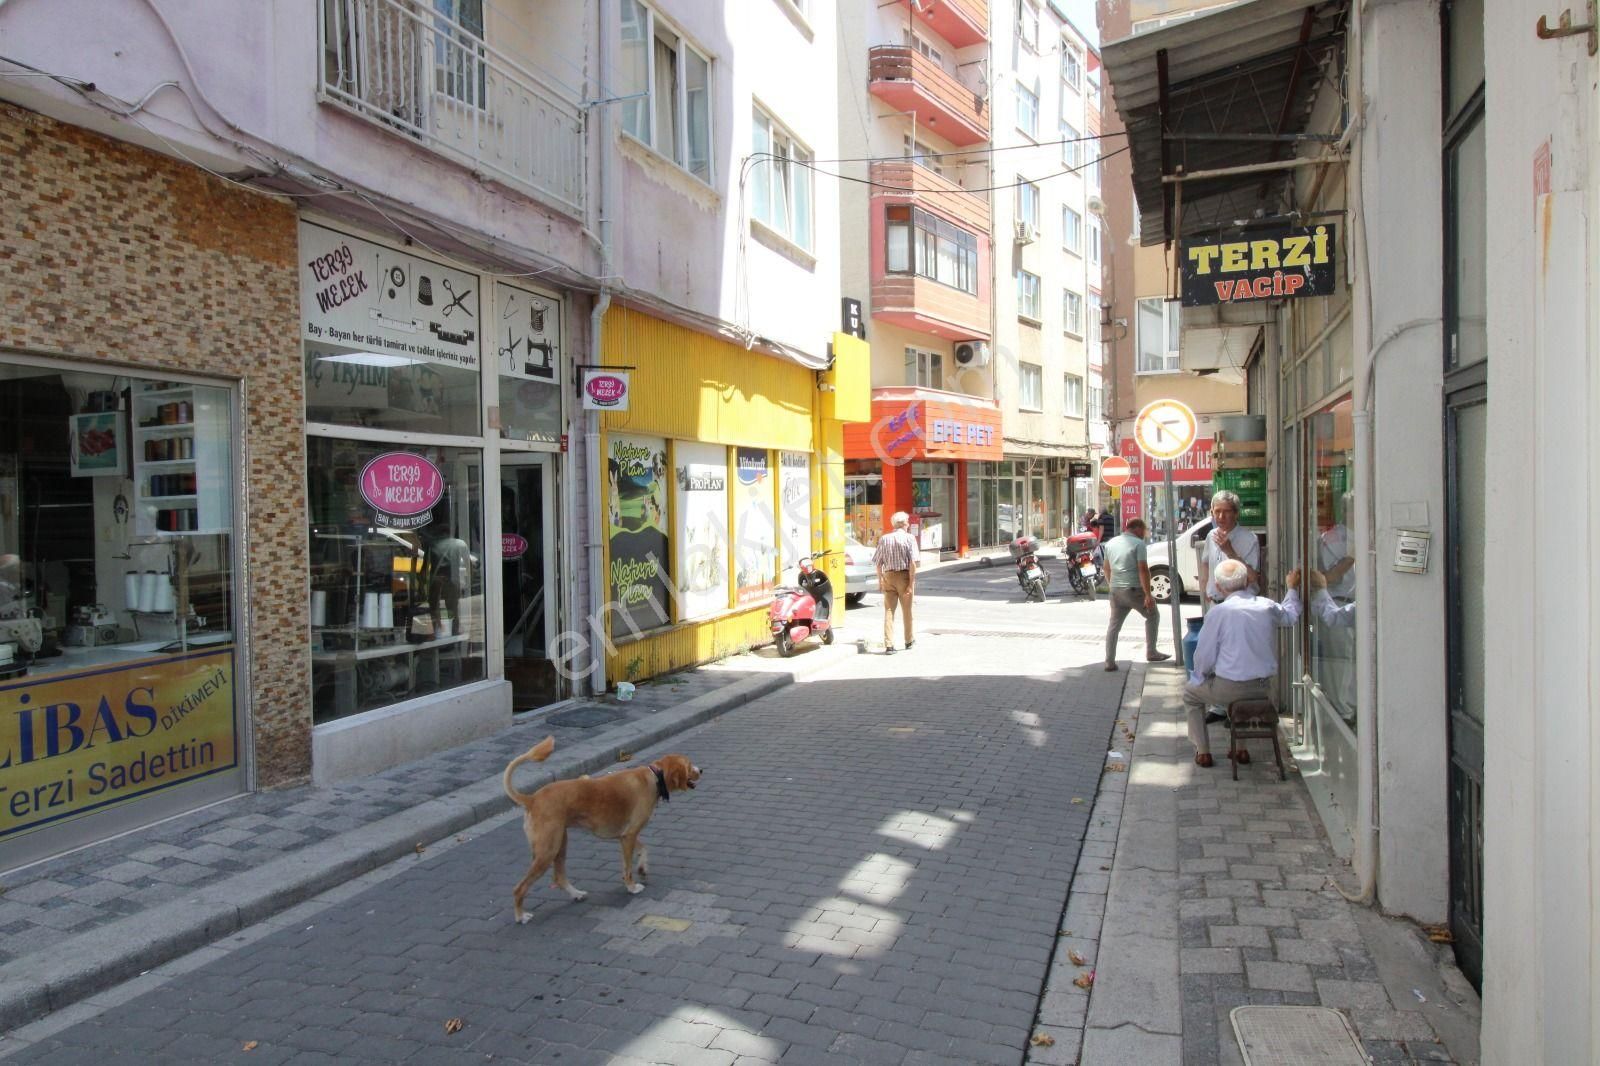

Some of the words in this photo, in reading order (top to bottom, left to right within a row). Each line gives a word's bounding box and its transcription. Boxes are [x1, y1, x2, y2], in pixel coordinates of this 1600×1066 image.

[1188, 225, 1328, 275] TERZİ
[316, 270, 368, 314] MELEK
[1214, 270, 1305, 301] VACİP
[308, 322, 322, 337] Bay
[329, 327, 350, 342] Bayan
[353, 331, 364, 342] her
[366, 335, 382, 347] türlü
[383, 339, 407, 351] tamirat
[408, 344, 415, 353] ve
[932, 419, 961, 444] EFE
[967, 424, 993, 447] PET
[613, 440, 651, 461] Nature
[388, 463, 421, 485] TERZİ
[619, 459, 646, 478] Plan
[385, 486, 424, 504] MELEK
[610, 557, 659, 587] Nature
[617, 582, 652, 609] Plan
[160, 668, 227, 731] DİKİMEVİ
[0, 687, 158, 769] İBAS
[88, 738, 214, 796] Sadettin
